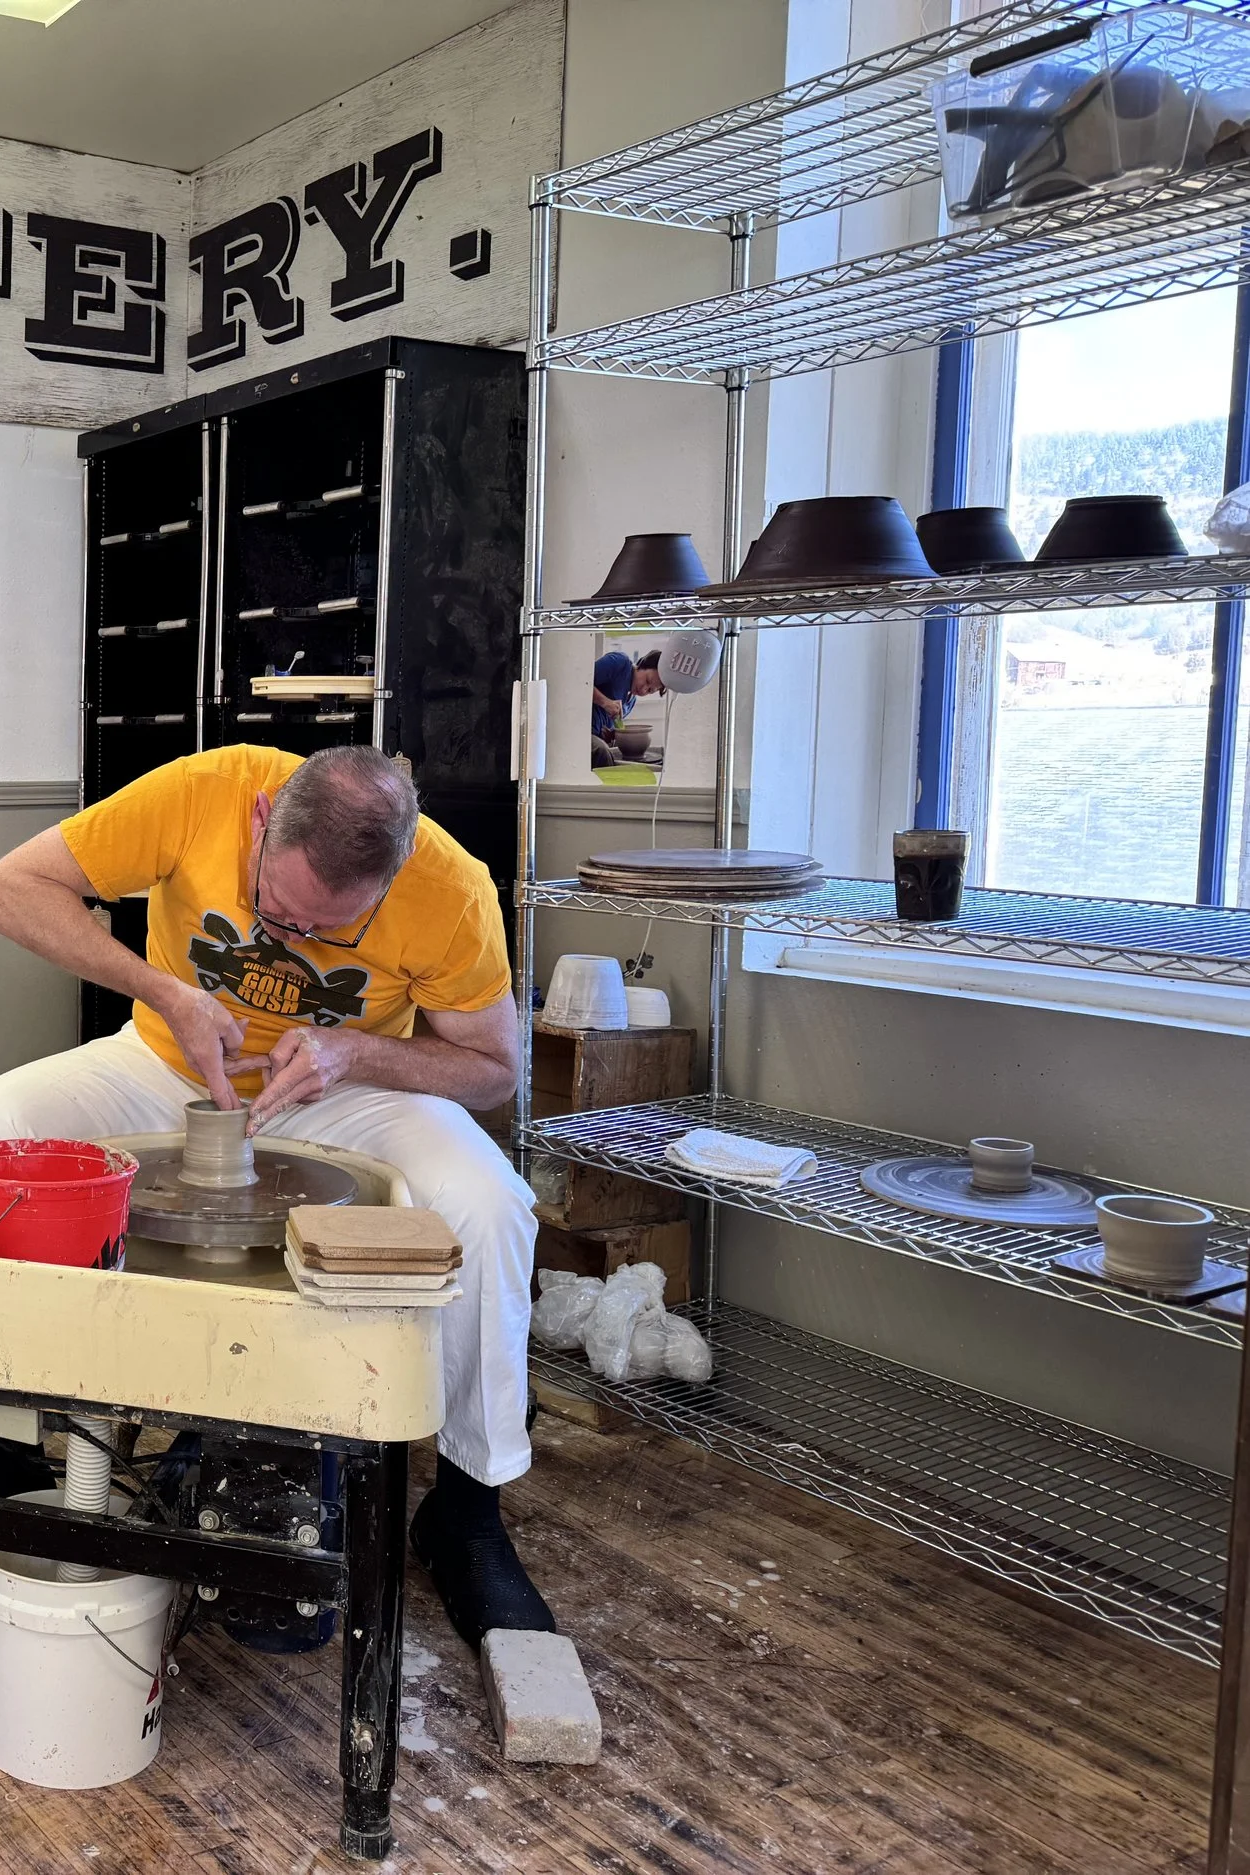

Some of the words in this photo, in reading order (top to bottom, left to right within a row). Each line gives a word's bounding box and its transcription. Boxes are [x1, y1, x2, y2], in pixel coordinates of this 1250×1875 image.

[670, 651, 703, 679] JBL
[242, 972, 301, 1002] GOLD
[243, 962, 286, 979] VIRGINIA
[286, 971, 309, 989] CITY
[237, 984, 299, 1014] RUSH
